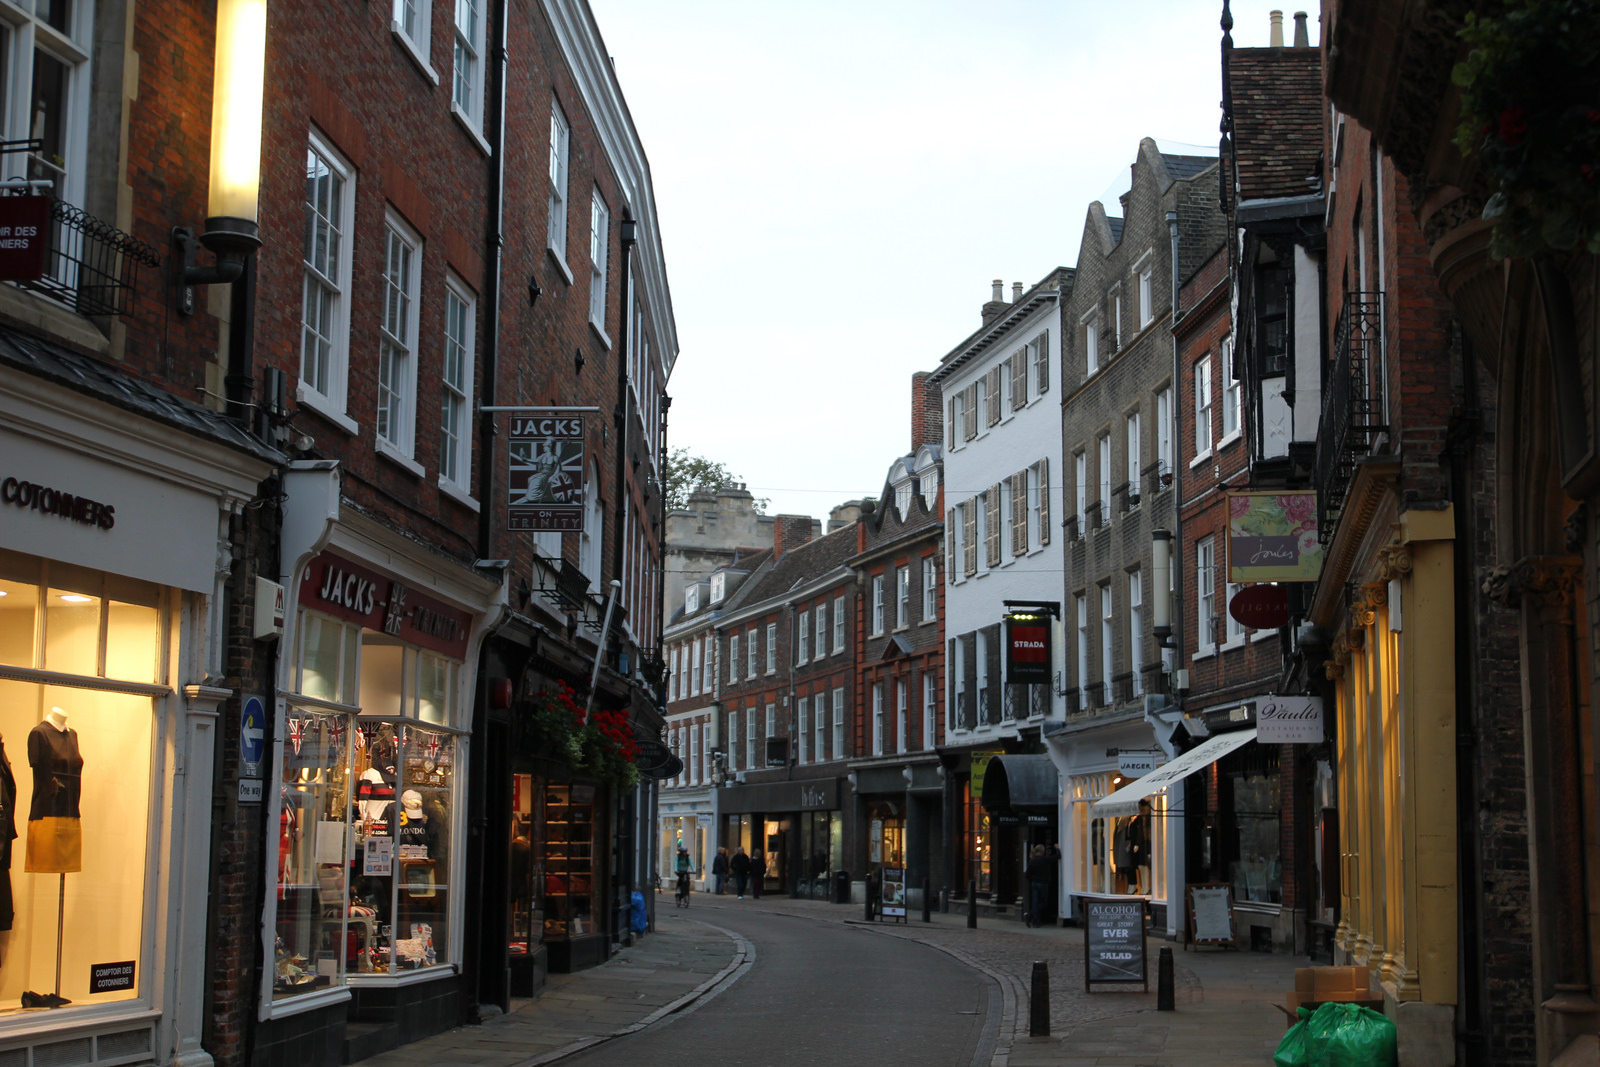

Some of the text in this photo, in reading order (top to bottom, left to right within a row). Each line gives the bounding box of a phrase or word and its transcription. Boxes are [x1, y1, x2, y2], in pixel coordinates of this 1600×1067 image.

[15, 225, 38, 237] DES
[511, 419, 582, 435] JACKS
[2, 476, 116, 530] COTONNIERS
[511, 518, 581, 529] TRINITY
[321, 564, 377, 616] JACKS
[414, 605, 461, 642] TRINITY
[1013, 640, 1045, 649] STRADA
[1261, 703, 1320, 721] Vaults
[1120, 762, 1152, 770] JAEGER
[240, 784, 261, 798] One way
[1091, 905, 1137, 915] ALCOHOL
[1102, 929, 1129, 938] EVER
[1100, 952, 1132, 960] SALAD
[96, 966, 133, 978] COMPTOIR DES
[97, 977, 129, 989] COTONNIERS
